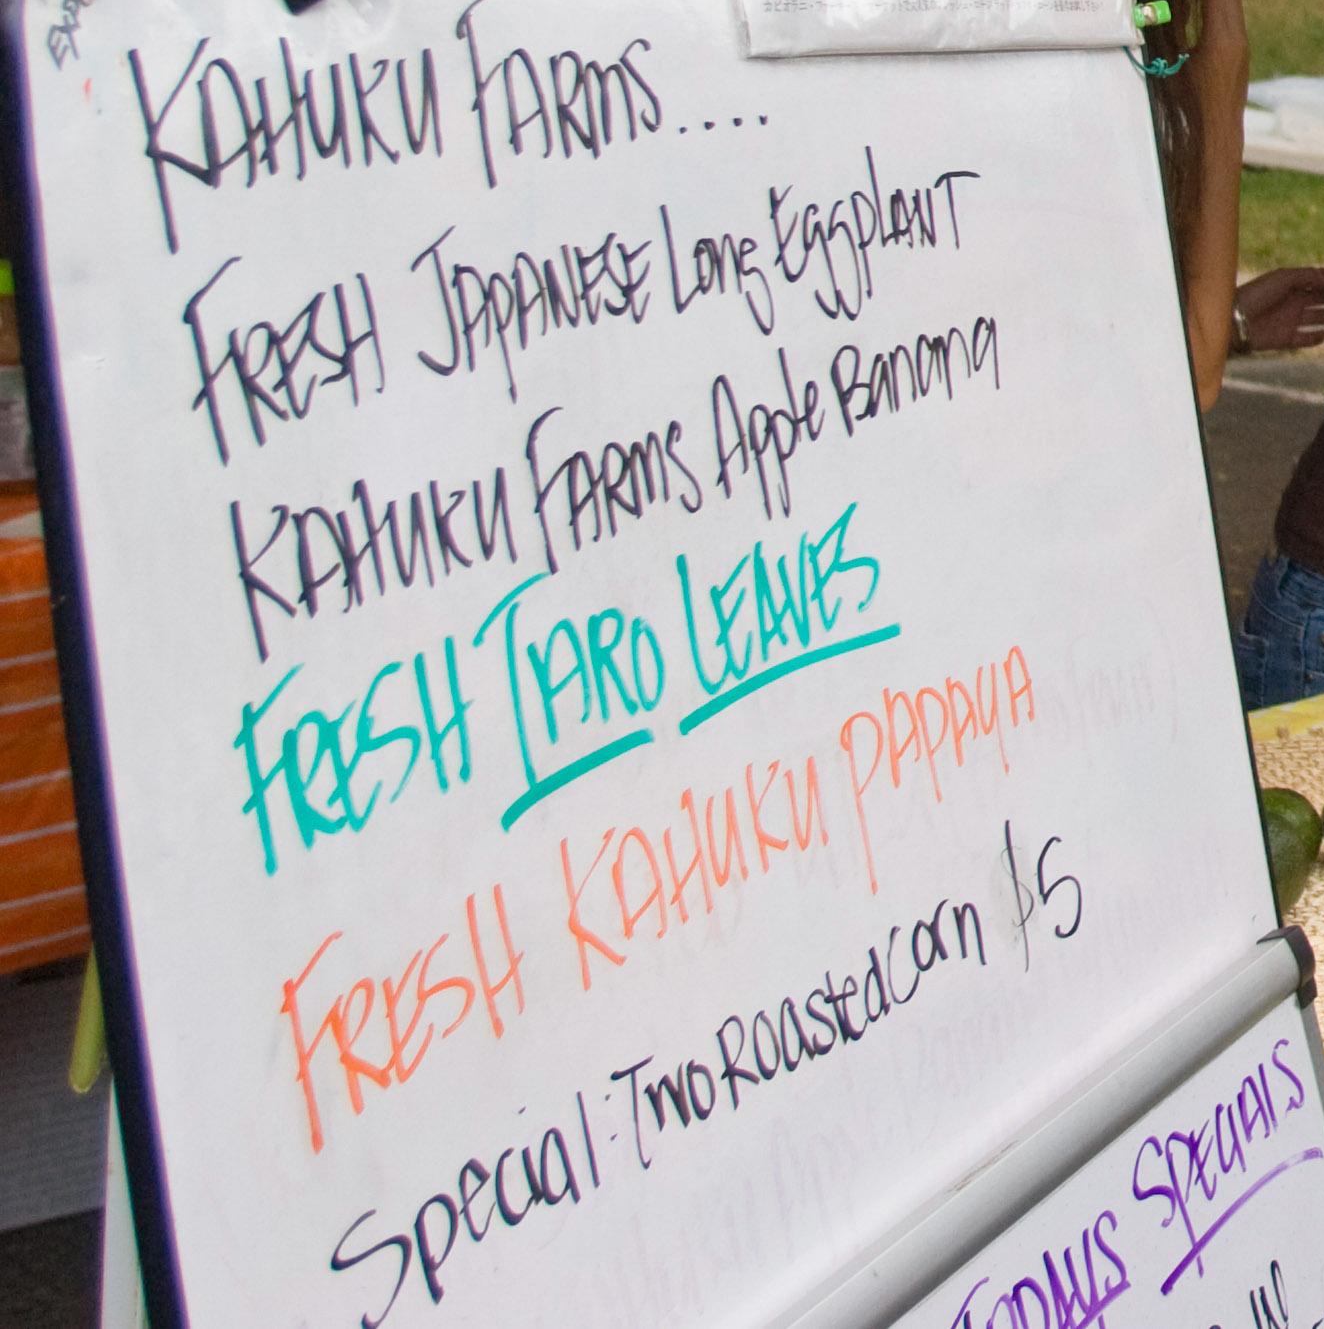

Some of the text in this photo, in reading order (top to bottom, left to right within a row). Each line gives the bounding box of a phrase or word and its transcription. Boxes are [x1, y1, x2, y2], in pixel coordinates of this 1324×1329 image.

[127, 37, 443, 255] KAHUKU
[183, 256, 386, 467] FRESH
[411, 225, 653, 404] JAPANESE
[230, 467, 518, 663] KAHUKU
[233, 502, 880, 877] FRESH TARO LEAVES
[281, 646, 1035, 1155] FRESH KAHUKU PAPAYA
[999, 821, 1084, 973] $5
